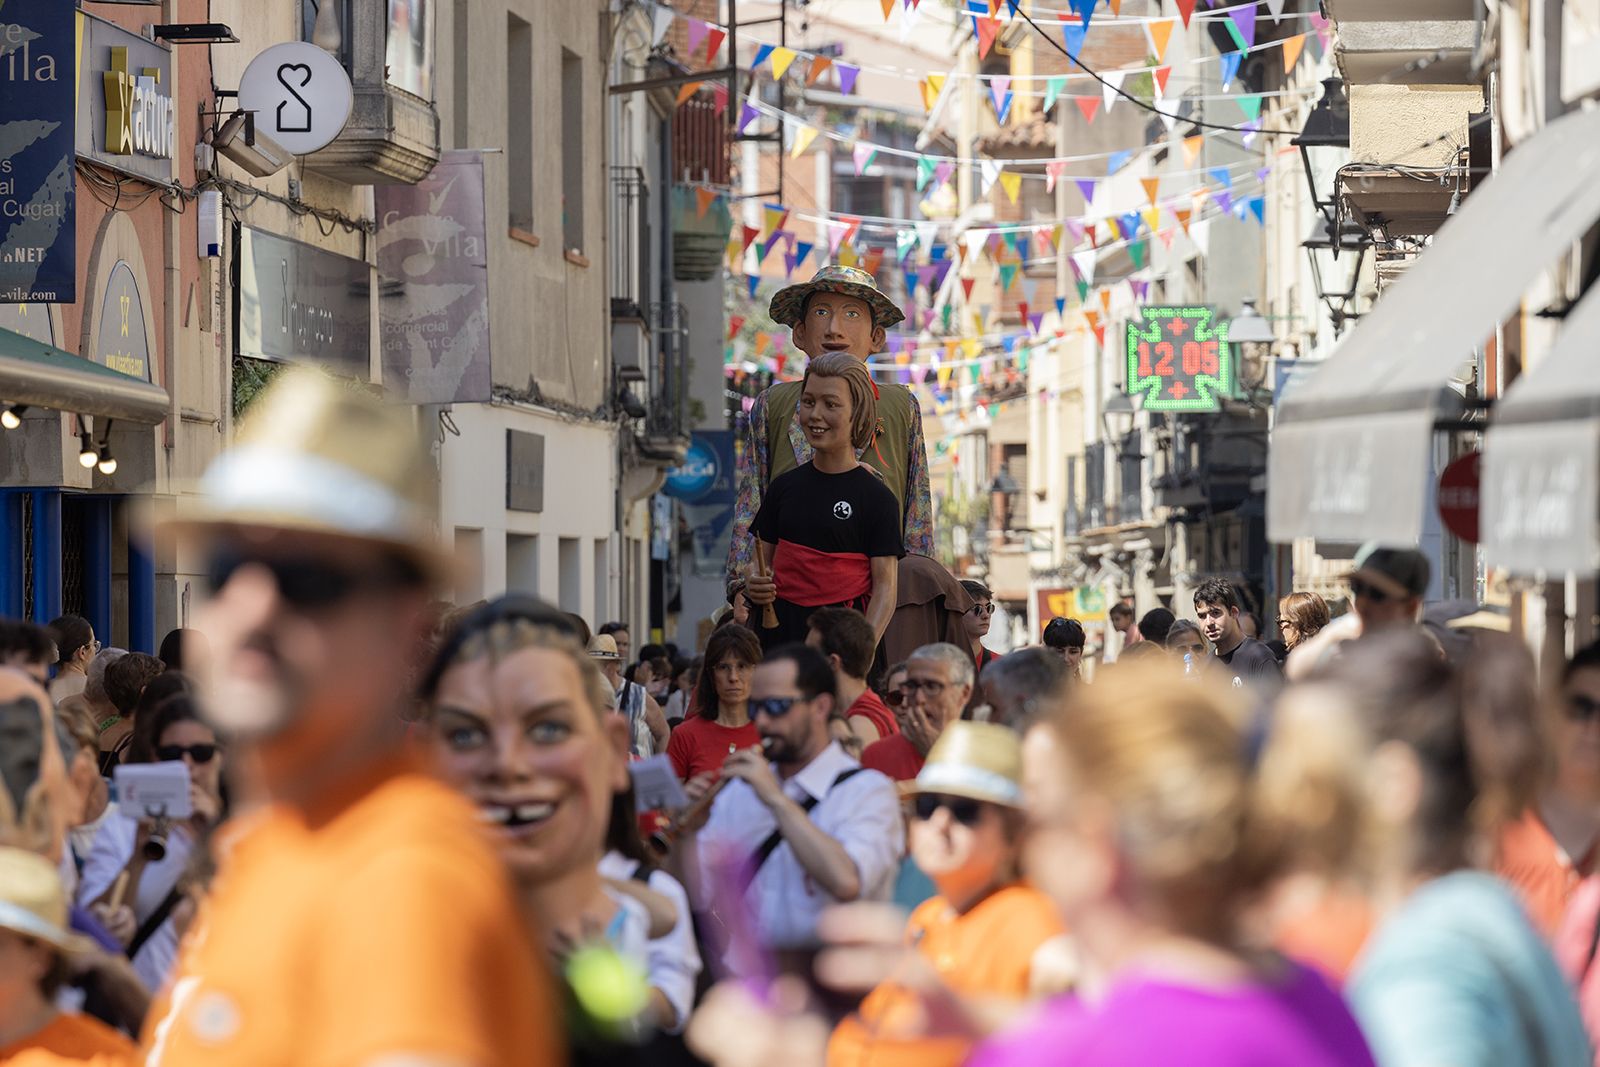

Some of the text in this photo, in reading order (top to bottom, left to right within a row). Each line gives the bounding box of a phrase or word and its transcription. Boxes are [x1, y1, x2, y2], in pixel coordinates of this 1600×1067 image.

[0, 23, 21, 43] e
[0, 39, 57, 81] ila
[0, 160, 12, 173] s
[3, 199, 61, 221] Cugat
[385, 319, 449, 334] comercial
[386, 339, 403, 351] de
[407, 338, 438, 350] Snt
